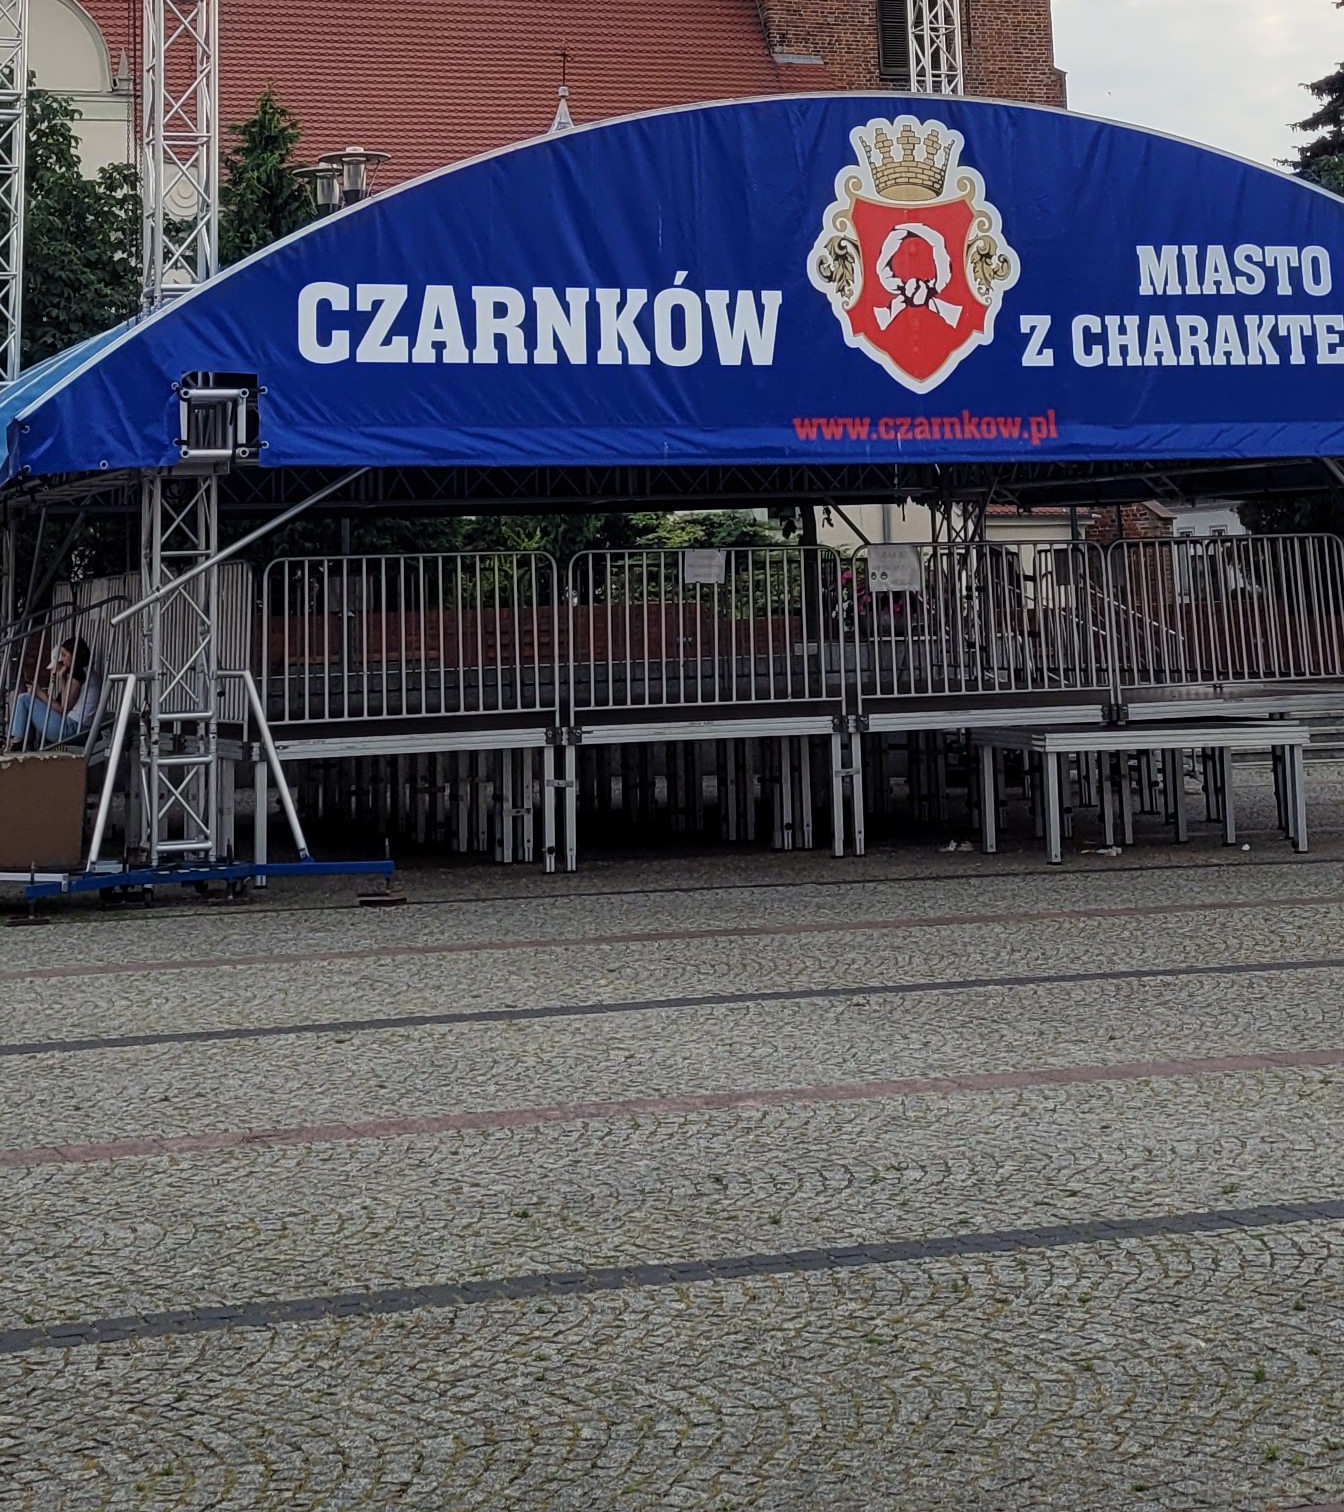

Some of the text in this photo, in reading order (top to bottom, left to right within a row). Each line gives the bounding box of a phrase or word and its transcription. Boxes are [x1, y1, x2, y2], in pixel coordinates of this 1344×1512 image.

[1136, 244, 1332, 297] MIASTO
[297, 271, 783, 366] CZARNKÓW
[1020, 314, 1054, 367] Z
[792, 410, 1060, 445] www.czarnkow.pl
